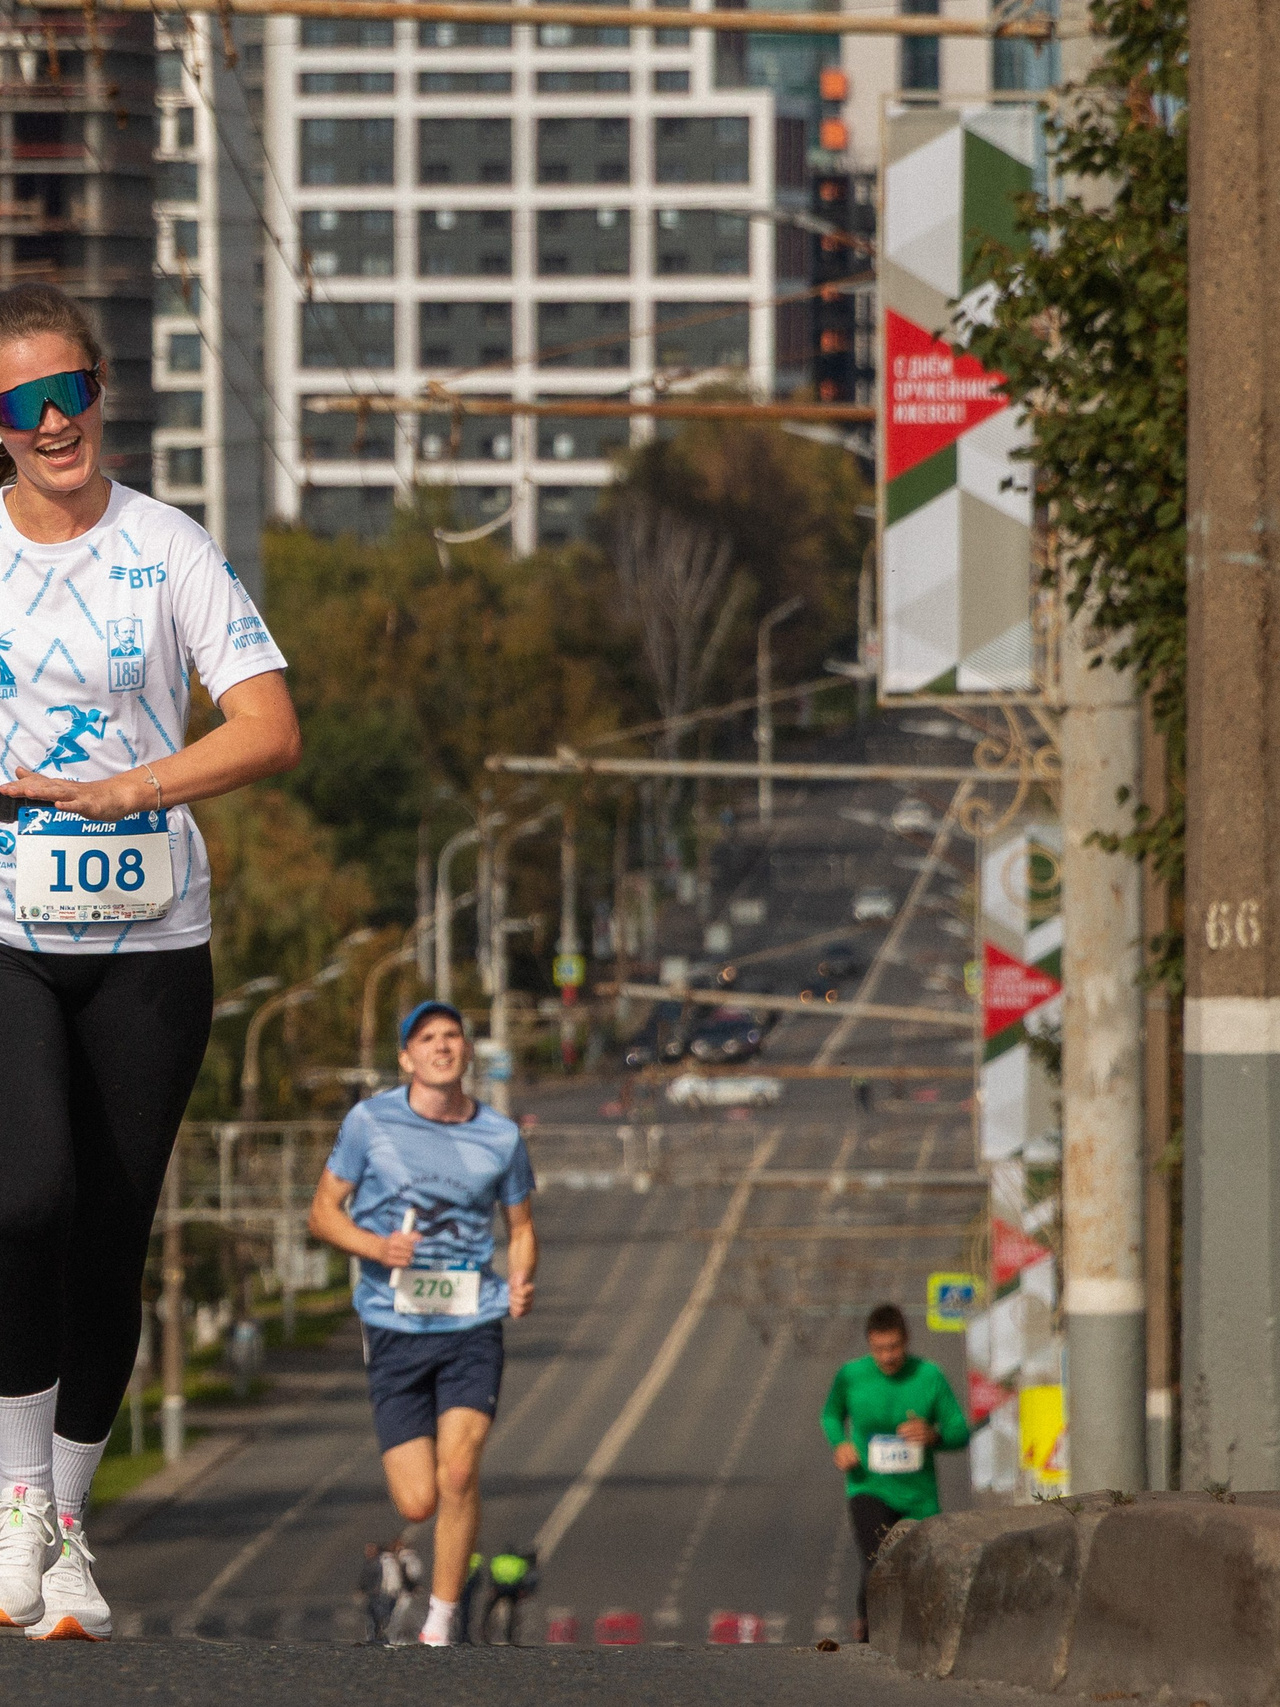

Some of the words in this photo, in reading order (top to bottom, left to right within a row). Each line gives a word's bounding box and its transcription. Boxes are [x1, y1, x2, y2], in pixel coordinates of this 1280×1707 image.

[114, 661, 140, 687] 185
[81, 823, 117, 833] МИЛЯ
[49, 848, 146, 893] 108
[1205, 900, 1261, 950] 66
[413, 1278, 454, 1299] 270
